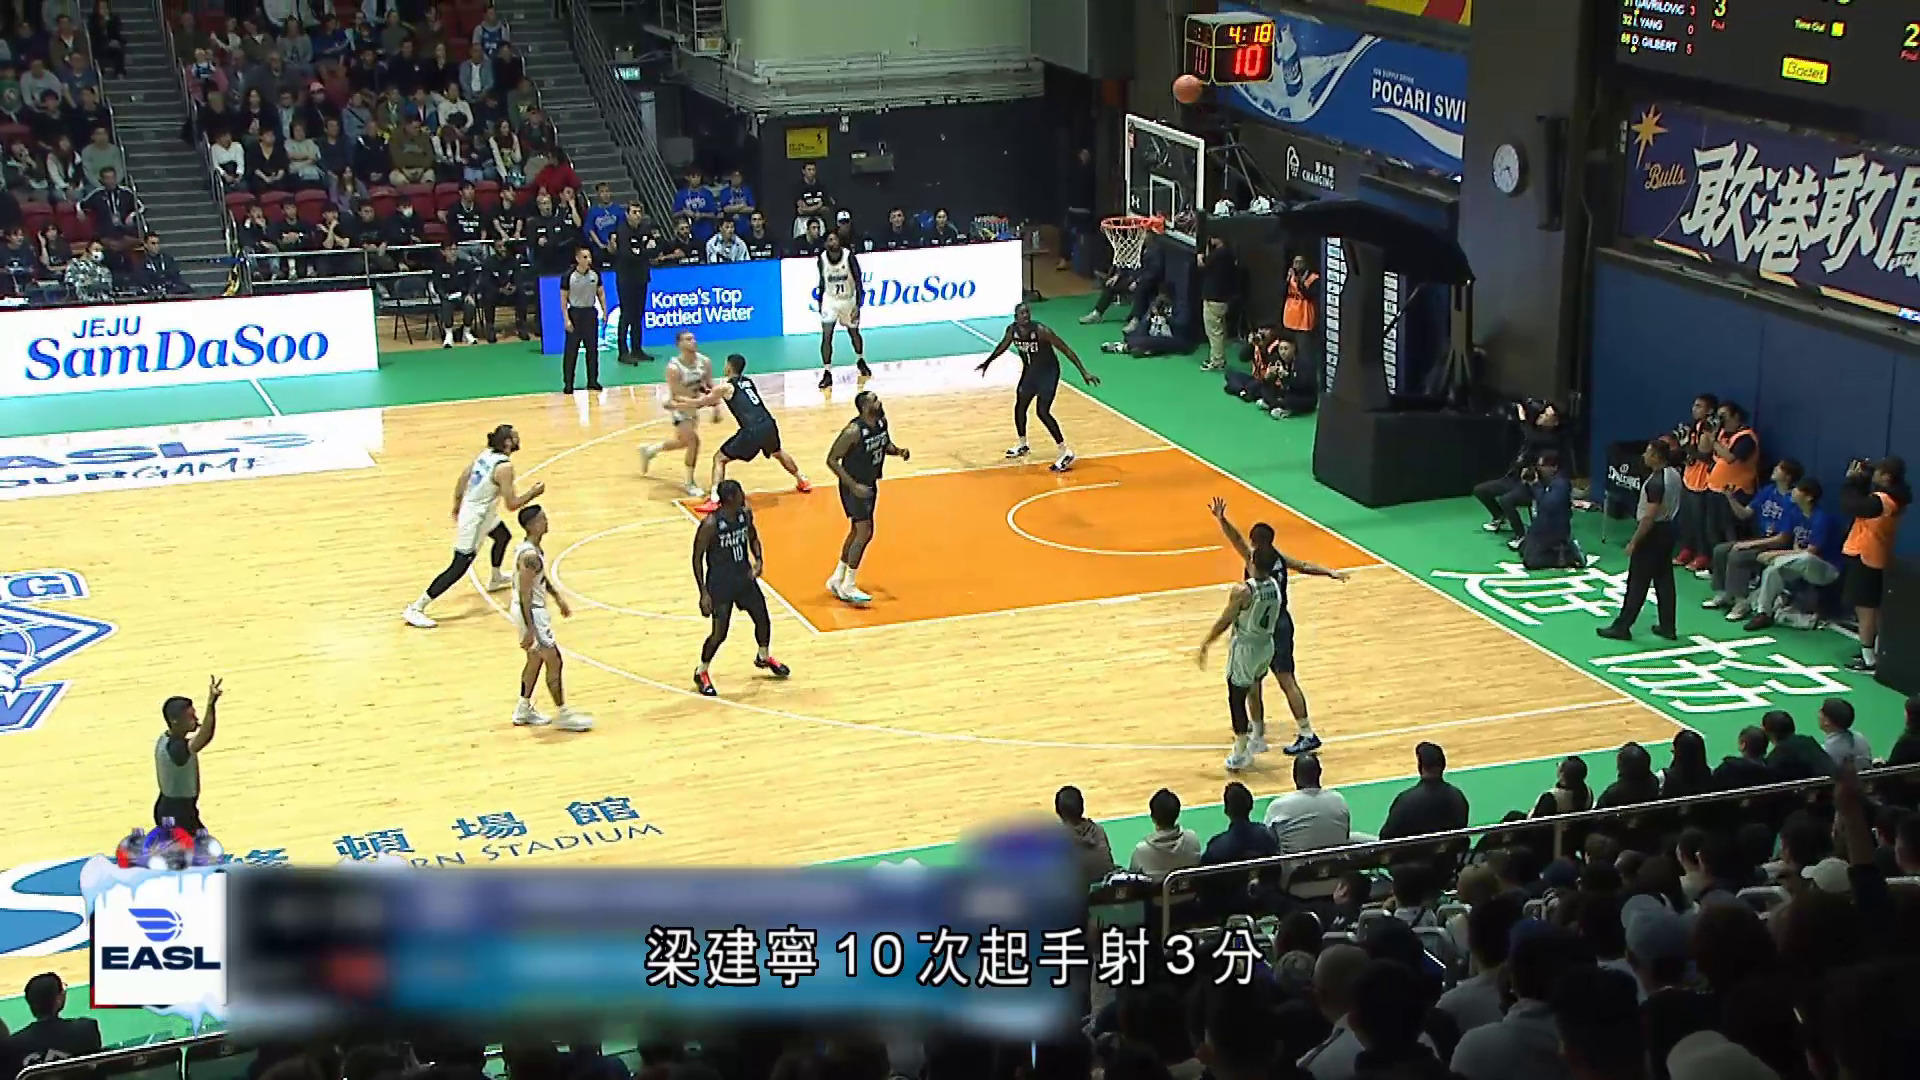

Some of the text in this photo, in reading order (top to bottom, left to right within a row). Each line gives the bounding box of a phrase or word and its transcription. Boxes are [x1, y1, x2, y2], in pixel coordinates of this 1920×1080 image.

[1714, 0, 1727, 17] 3
[1229, 23, 1272, 44] 4:18
[1640, 17, 1663, 31] YANG
[1903, 23, 1920, 47] 2
[1641, 36, 1678, 53] GILBERT
[1234, 45, 1262, 76] 10
[1371, 77, 1431, 114] POCARI
[1645, 162, 1686, 189] Bulls
[651, 287, 742, 309] Korea's Top
[72, 315, 142, 339] JEJU
[644, 305, 755, 328] Bottled Water
[25, 324, 329, 381] SamDaSoo
[481, 822, 665, 862] STADIUM
